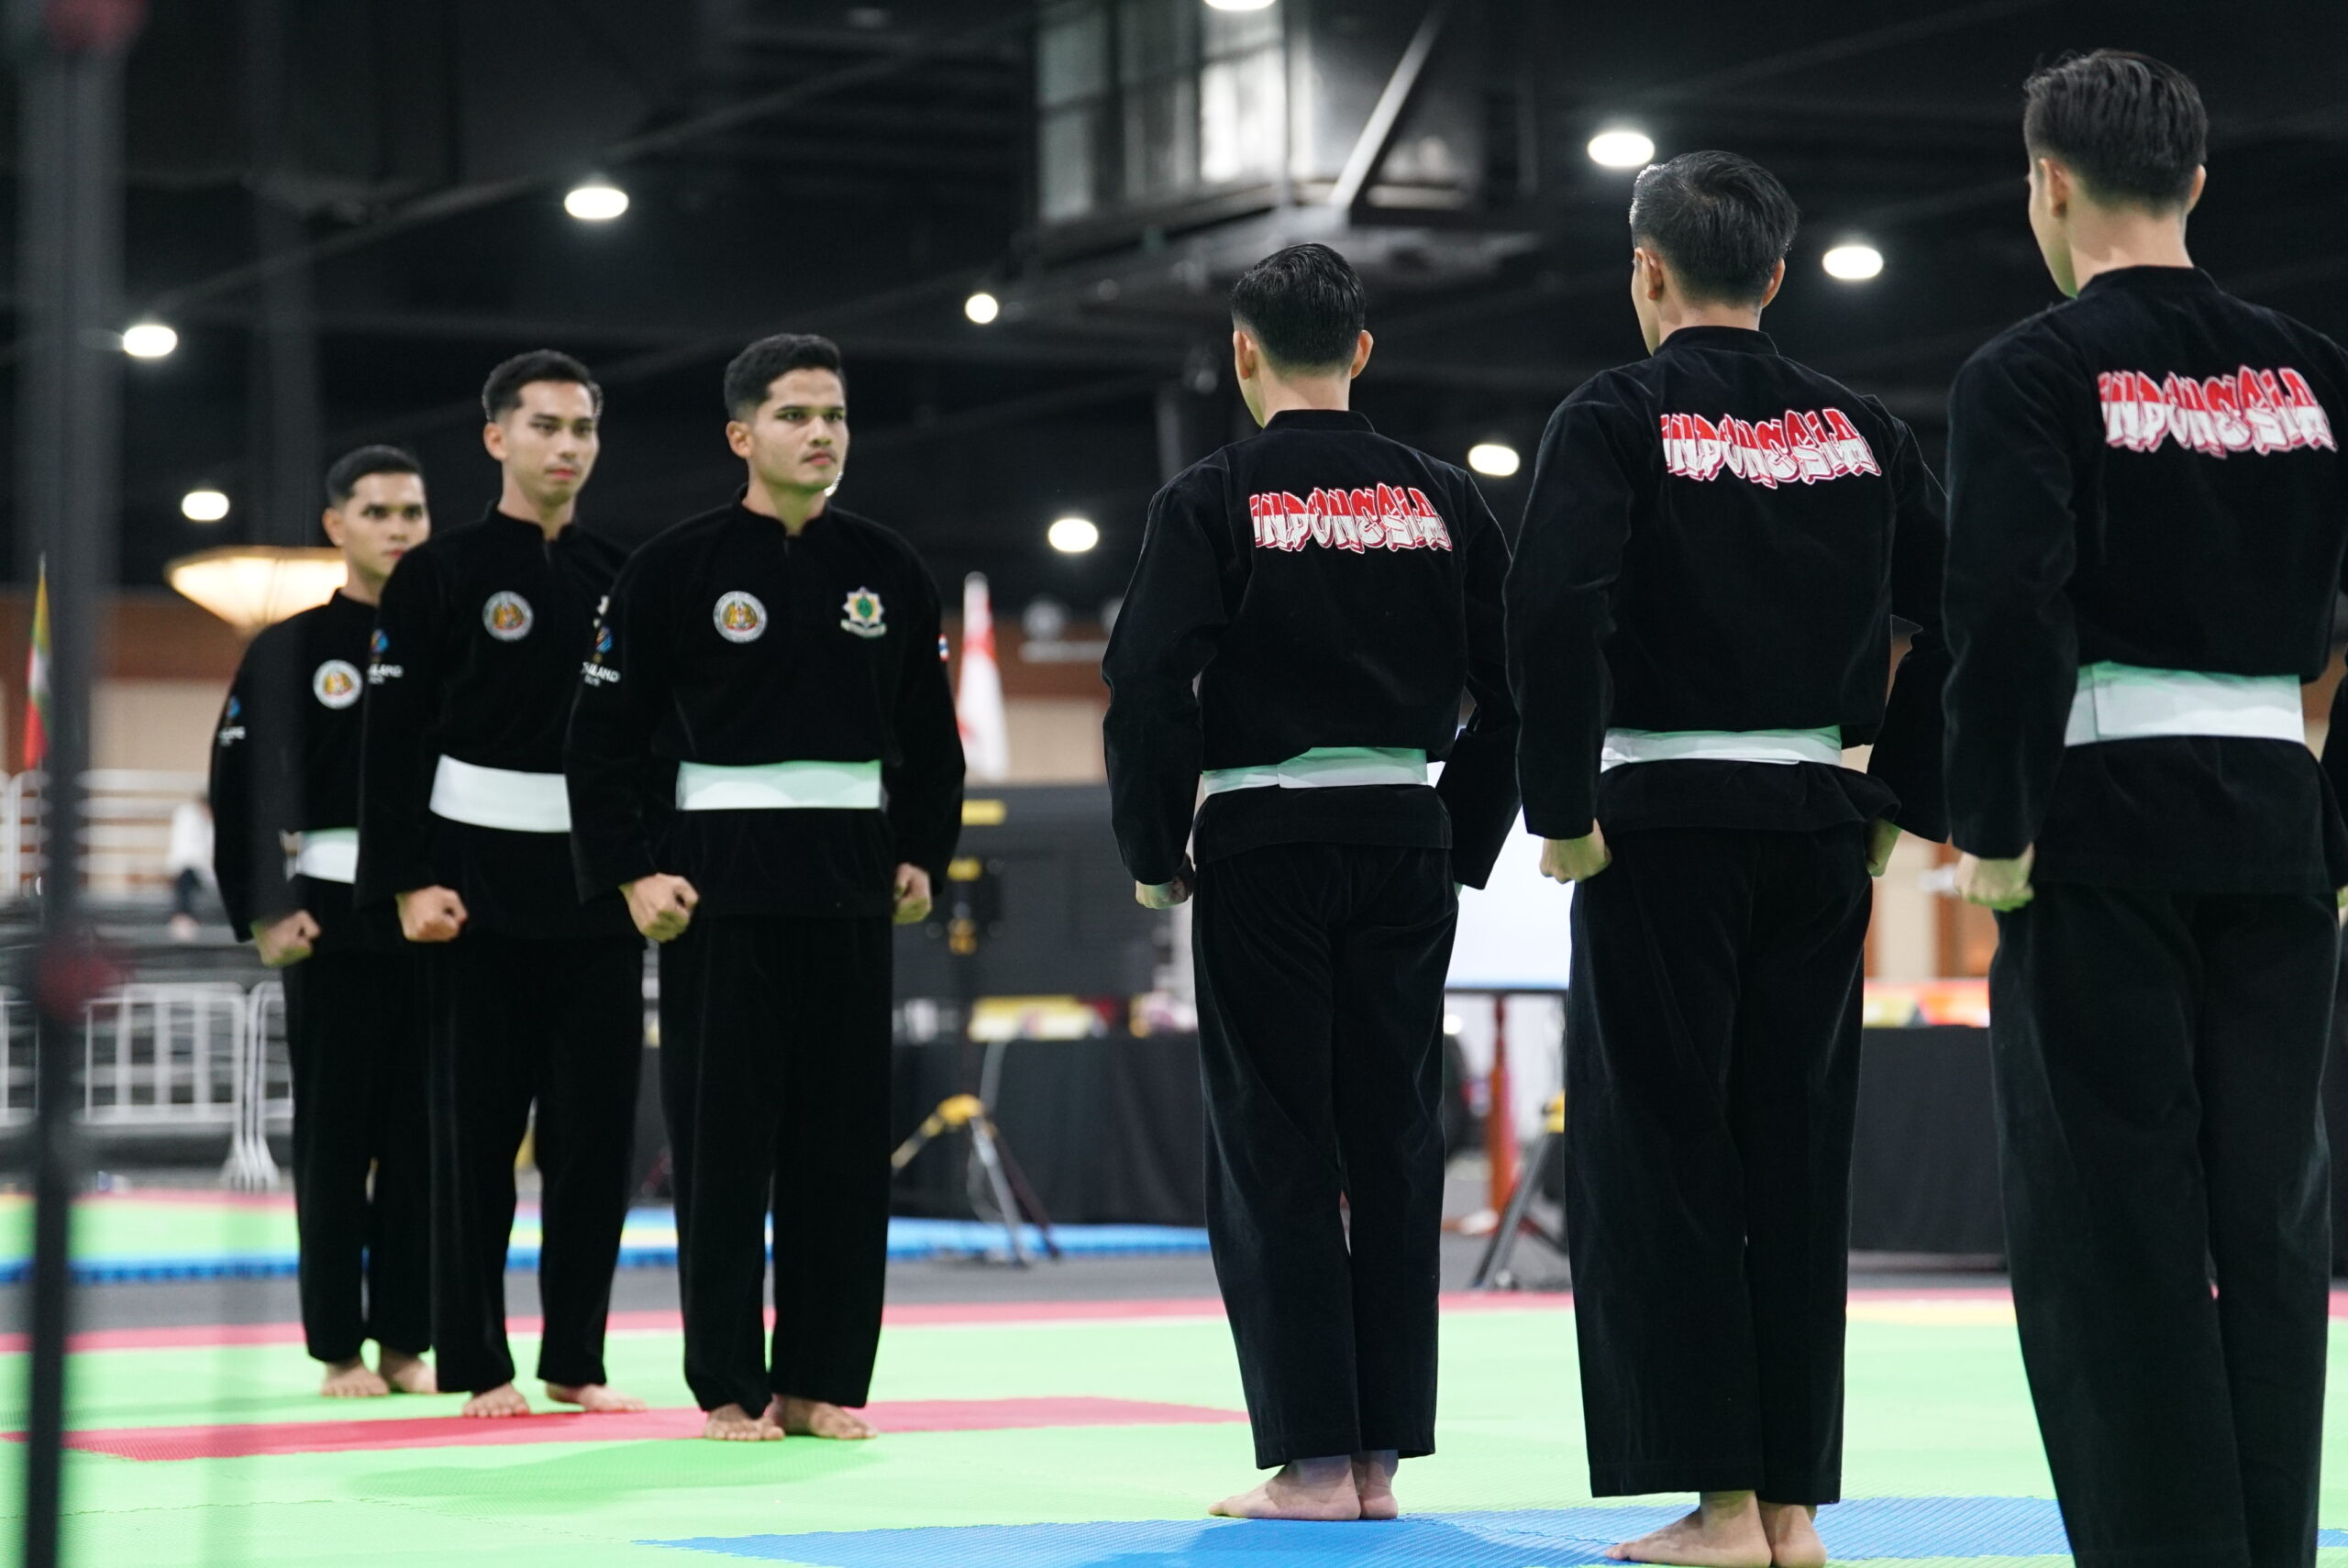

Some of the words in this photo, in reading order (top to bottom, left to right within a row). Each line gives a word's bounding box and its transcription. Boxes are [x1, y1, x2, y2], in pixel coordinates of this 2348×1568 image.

[1660, 407, 1881, 489] INDONESIA
[2098, 364, 2337, 458] INDONESIA
[1249, 482, 1452, 554] INDONESIA
